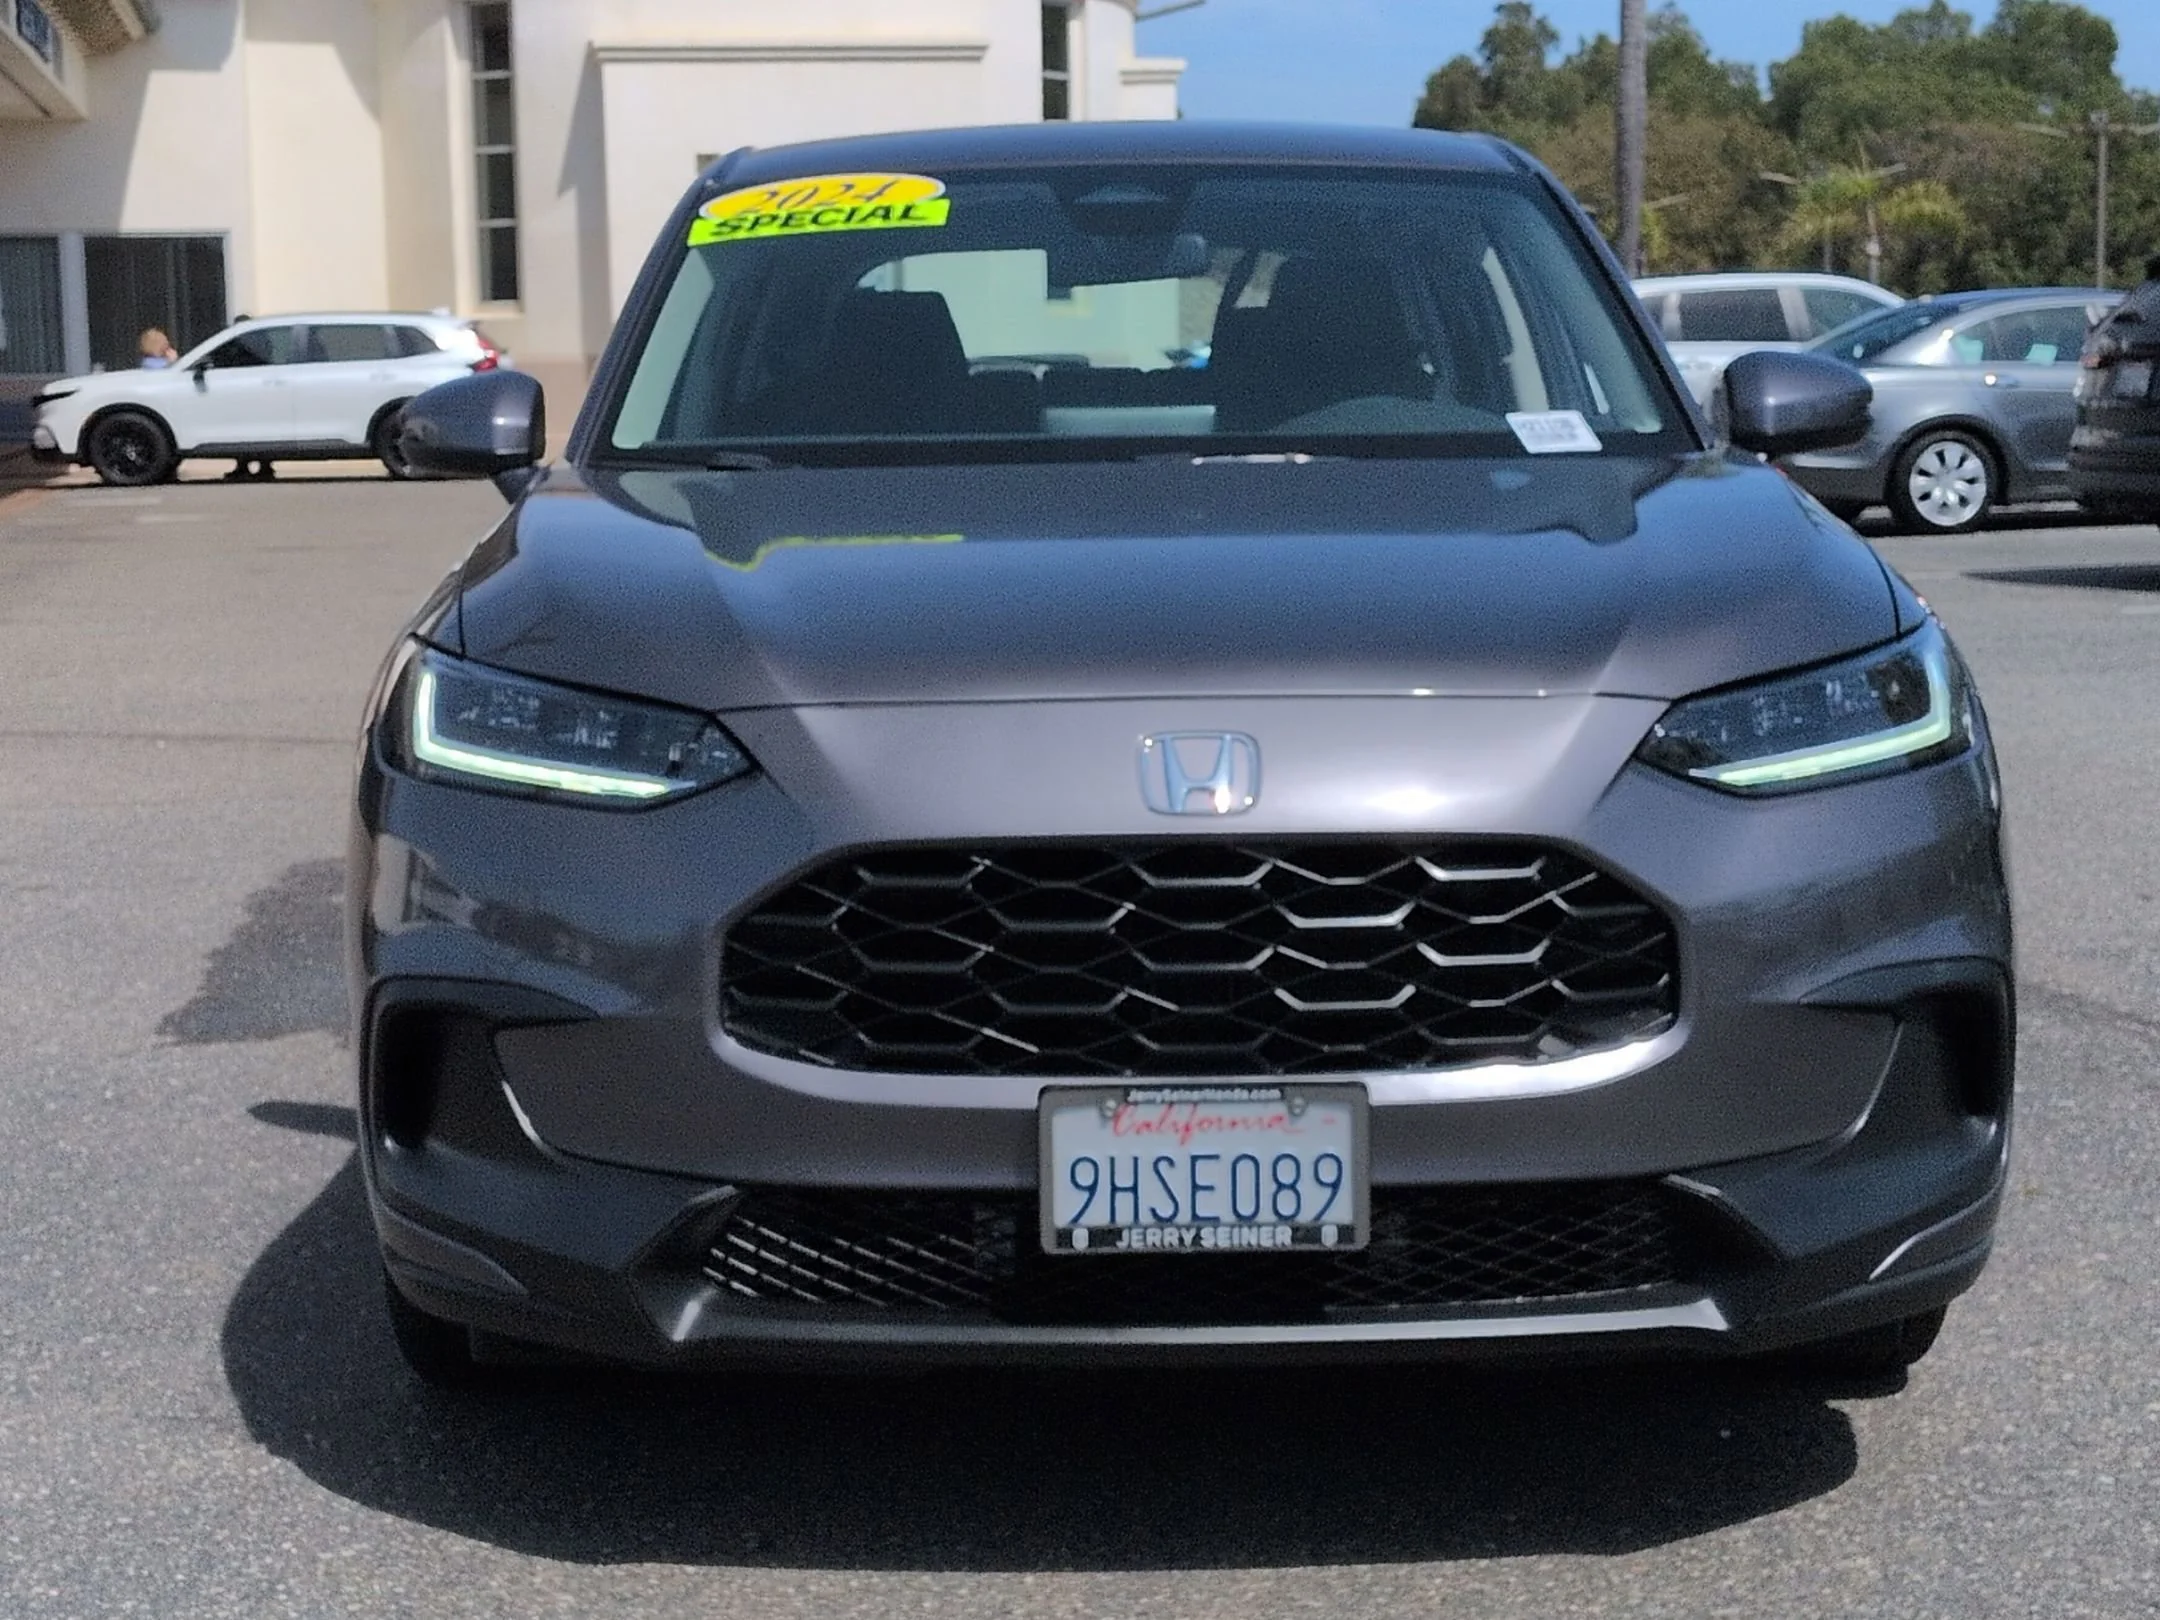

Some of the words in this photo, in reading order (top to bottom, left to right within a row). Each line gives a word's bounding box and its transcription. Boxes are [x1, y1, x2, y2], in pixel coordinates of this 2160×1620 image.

[738, 179, 899, 218] 2024
[709, 203, 927, 237] SPECIAL
[1113, 1102, 1304, 1146] California
[1069, 1153, 1344, 1225] 9HSE089
[1116, 1227, 1197, 1248] JERRY
[1200, 1226, 1293, 1248] SEINER
